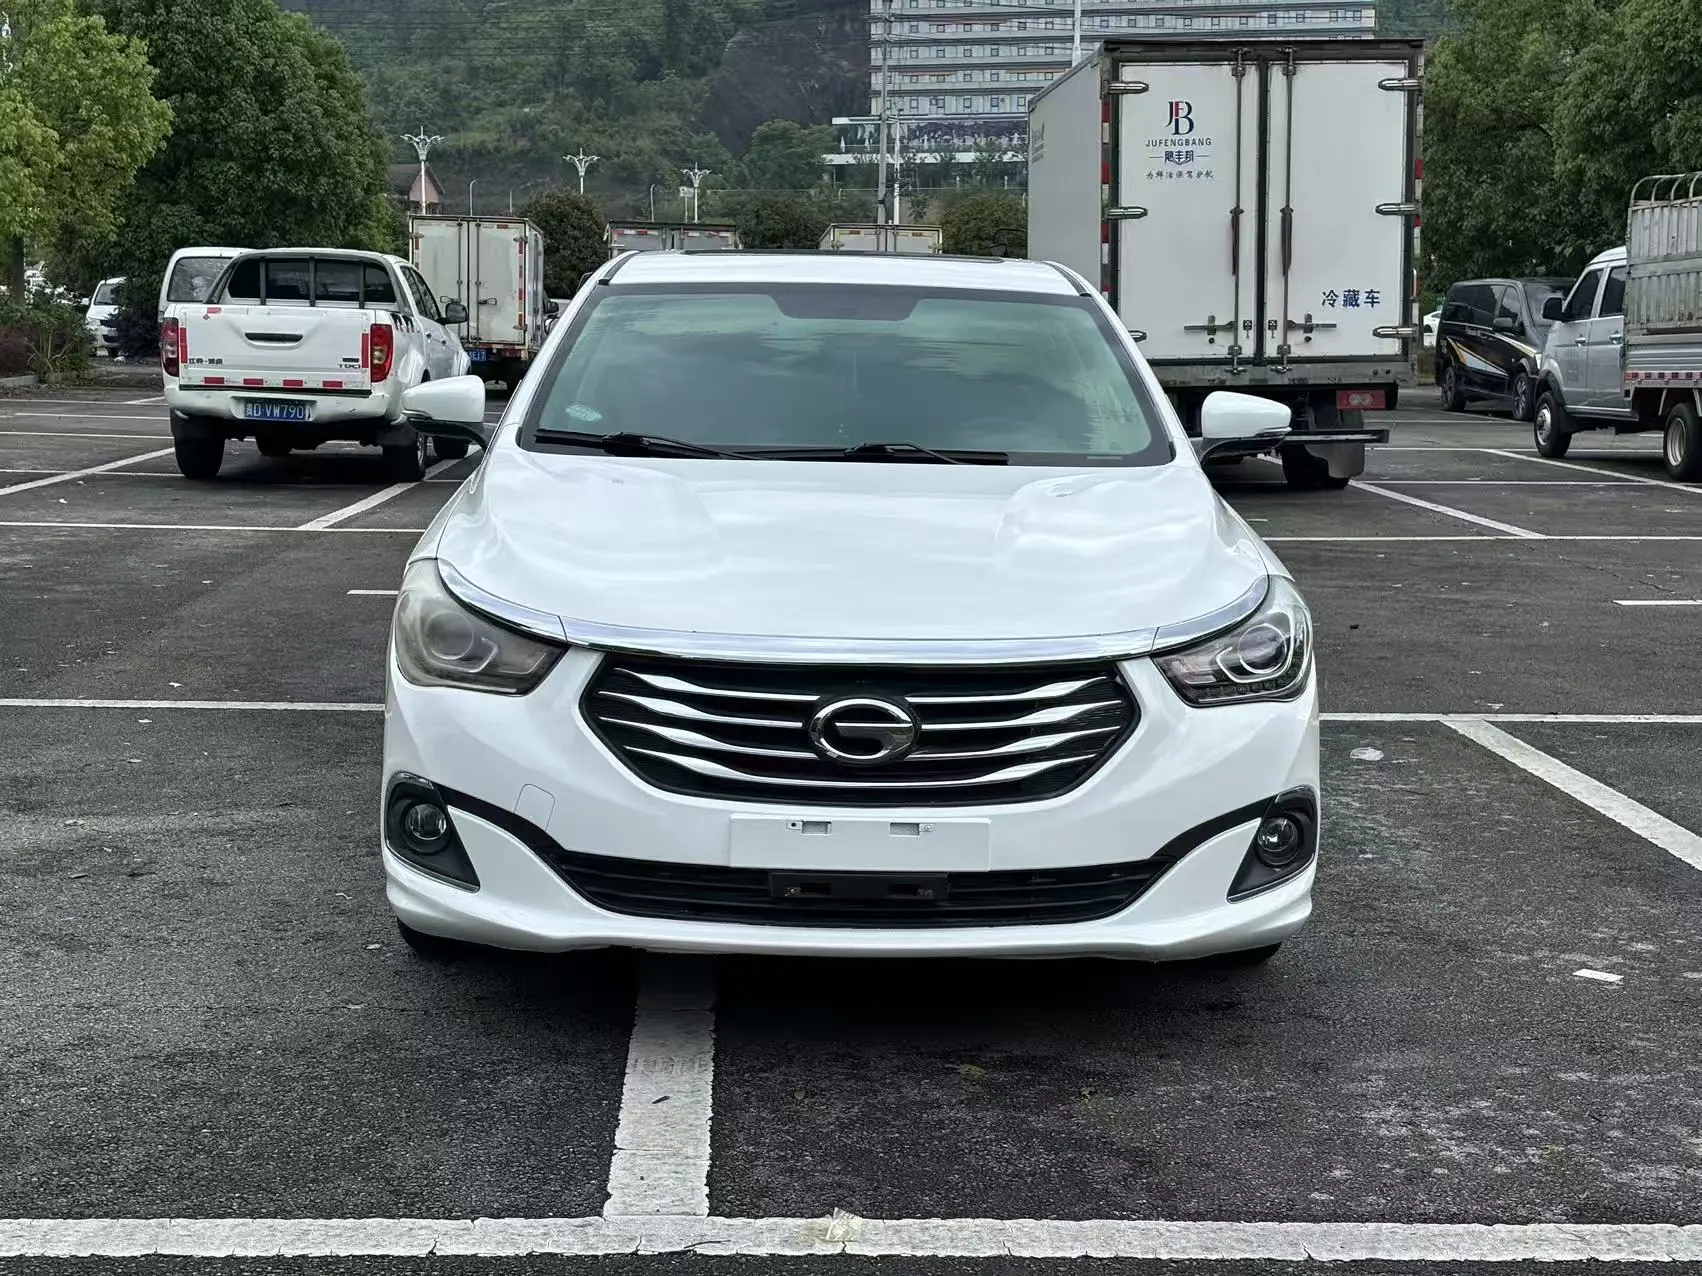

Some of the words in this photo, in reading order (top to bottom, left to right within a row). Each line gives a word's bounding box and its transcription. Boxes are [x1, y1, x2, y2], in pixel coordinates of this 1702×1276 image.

[1145, 137, 1212, 147] JUFENGBANG
[1321, 288, 1381, 308] 冷藏车
